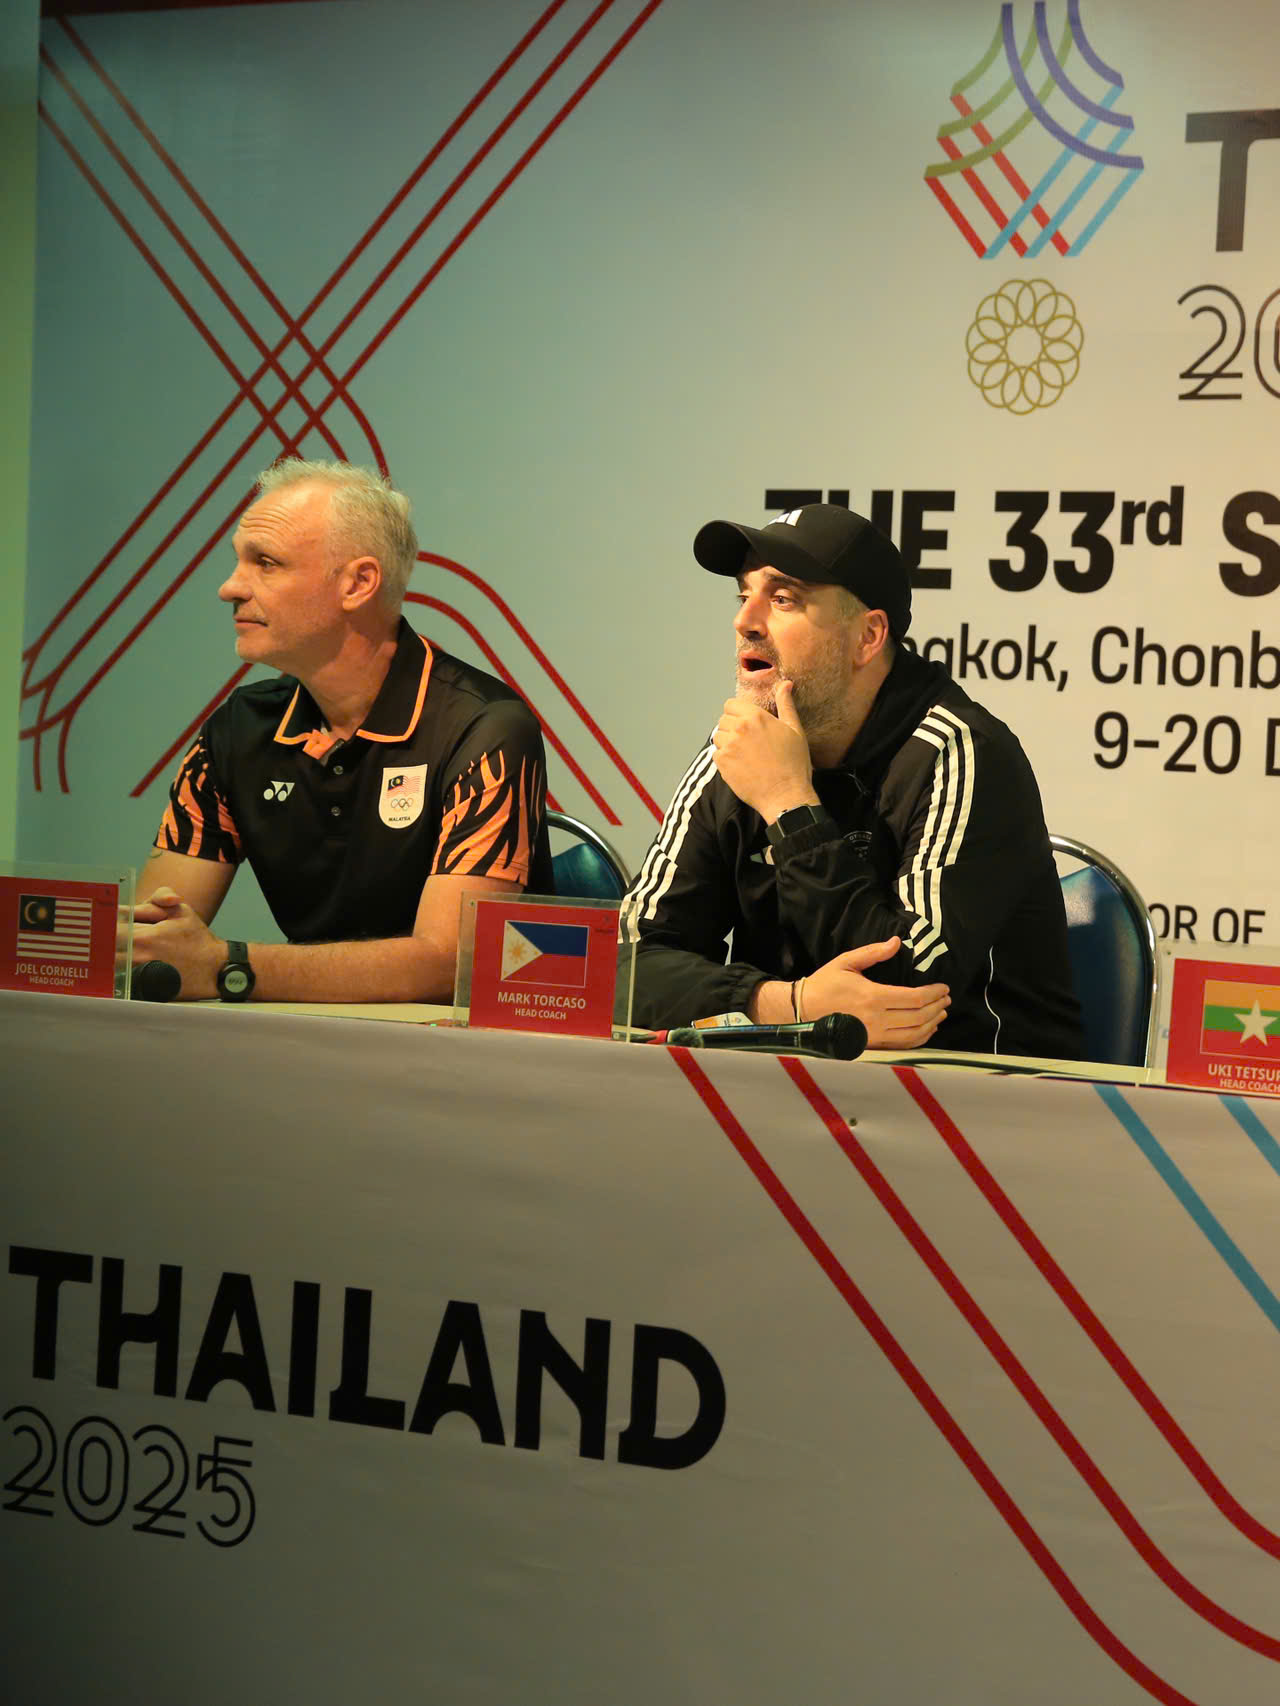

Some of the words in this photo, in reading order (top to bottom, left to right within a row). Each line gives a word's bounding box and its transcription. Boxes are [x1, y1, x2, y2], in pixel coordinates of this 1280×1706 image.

[988, 485, 1184, 594] 33rd
[1212, 907, 1266, 944] OF
[15, 963, 38, 975] JOEL
[40, 964, 89, 979] CORNELLI
[29, 976, 49, 985] HEAD
[49, 977, 75, 987] COACH
[497, 991, 531, 1005] MARK
[533, 994, 587, 1010] TORCASO
[515, 1007, 537, 1017] HEAD
[538, 1009, 567, 1020] COACH
[1208, 1063, 1232, 1077] UKI
[1219, 1078, 1246, 1089] HEAD
[8, 1244, 727, 1471] THAILAND
[1, 1404, 256, 1548] 2025
